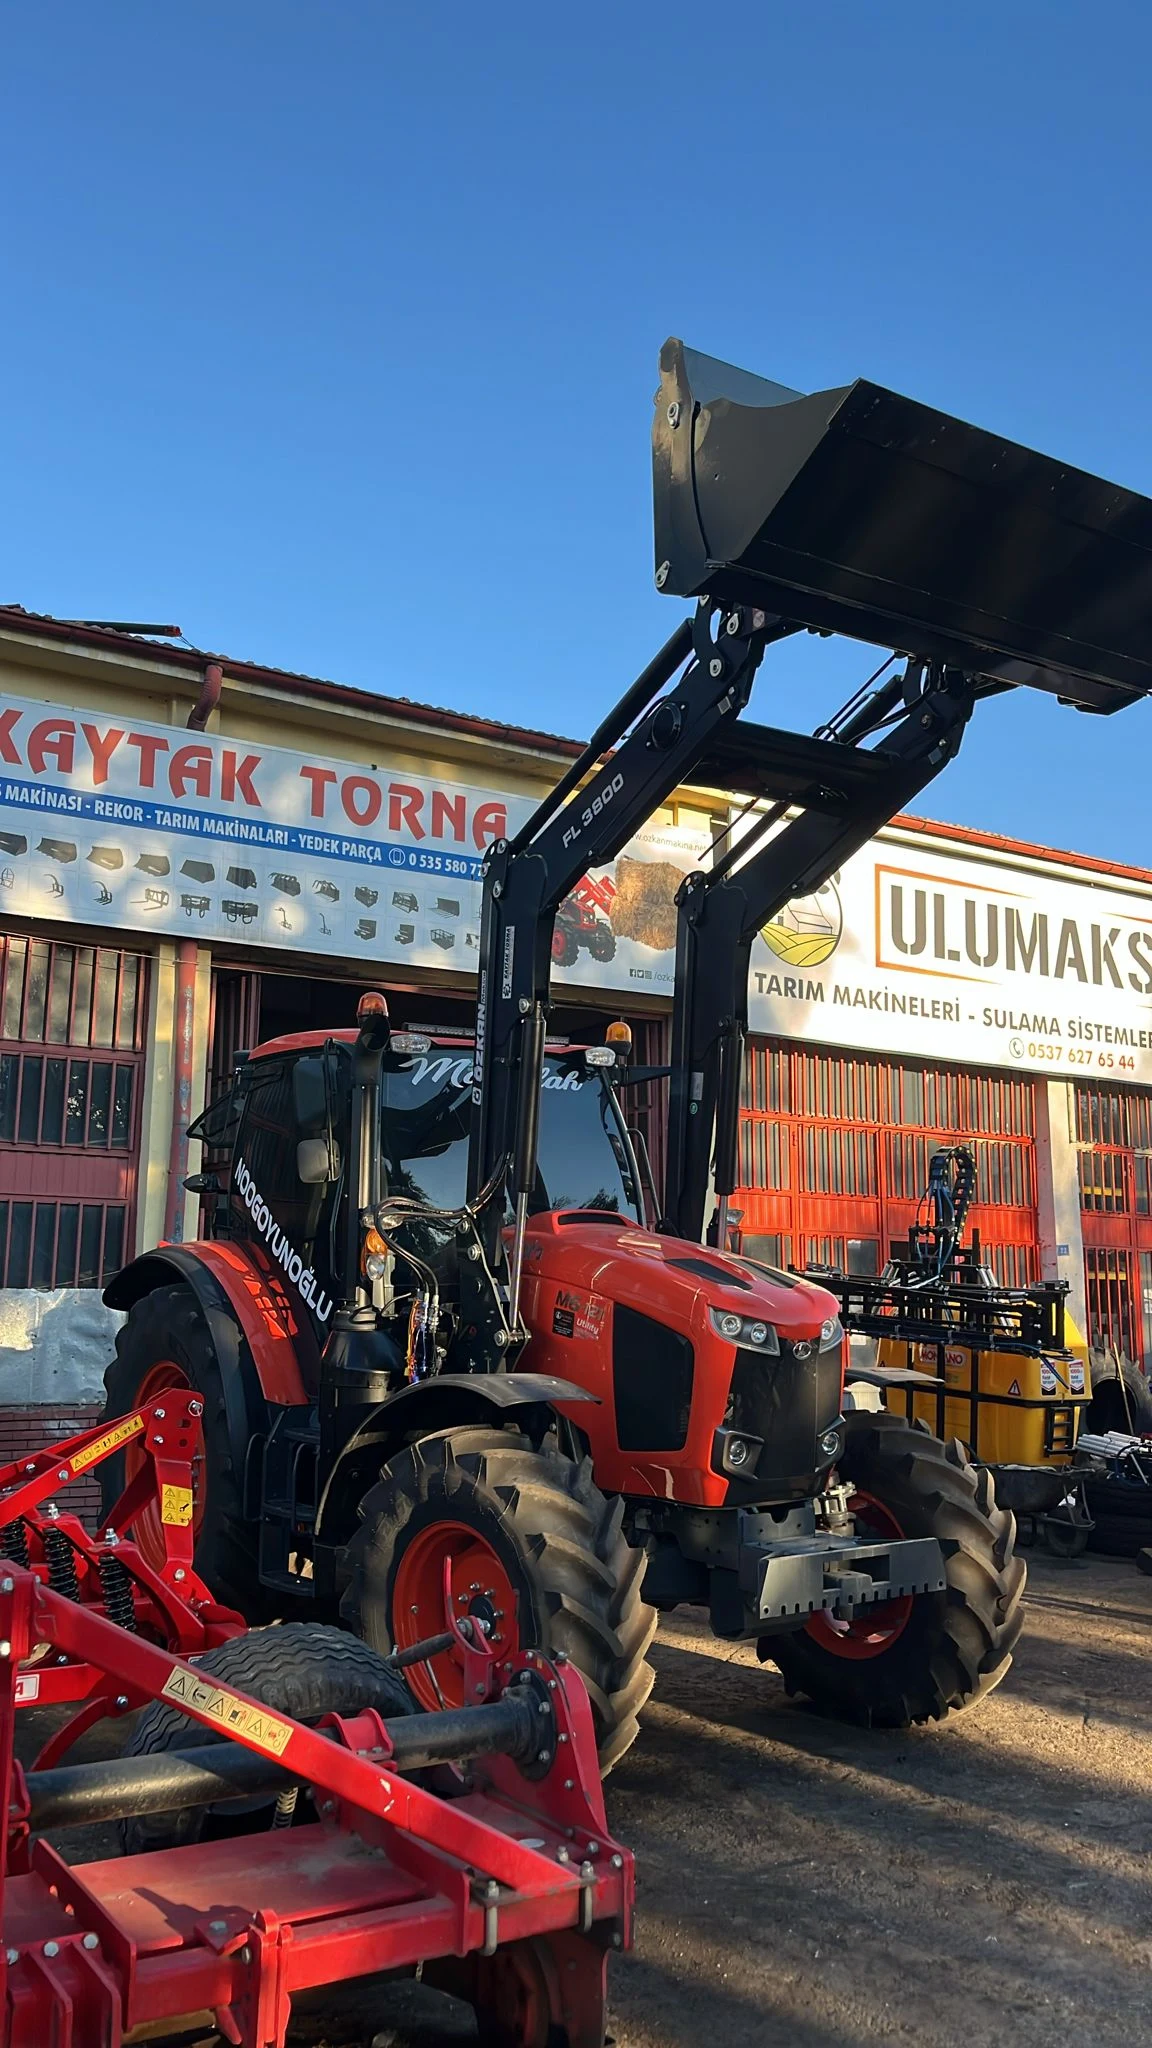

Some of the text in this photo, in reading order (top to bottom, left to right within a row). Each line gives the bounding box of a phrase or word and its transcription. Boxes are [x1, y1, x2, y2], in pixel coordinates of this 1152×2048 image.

[5, 784, 82, 812] MAKİNASI
[94, 800, 143, 821] REKOR
[155, 810, 200, 831] TARIM
[203, 818, 288, 846] MAKİNALARI
[299, 833, 339, 855] YEDEK
[342, 841, 382, 864] PARÇA
[409, 856, 417, 866] 0
[419, 857, 442, 870] 535
[445, 861, 467, 875] 580
[300, 766, 507, 850] TORNA
[562, 773, 624, 848] FL 3800
[891, 885, 1152, 994] ULUMAKS
[754, 972, 825, 1002] TARIM
[833, 986, 960, 1022] MAKİNELERİ
[983, 1008, 1061, 1036] SULAMA
[1028, 1043, 1135, 1070] 0537 627 65 44
[577, 1318, 599, 1335] Utility
